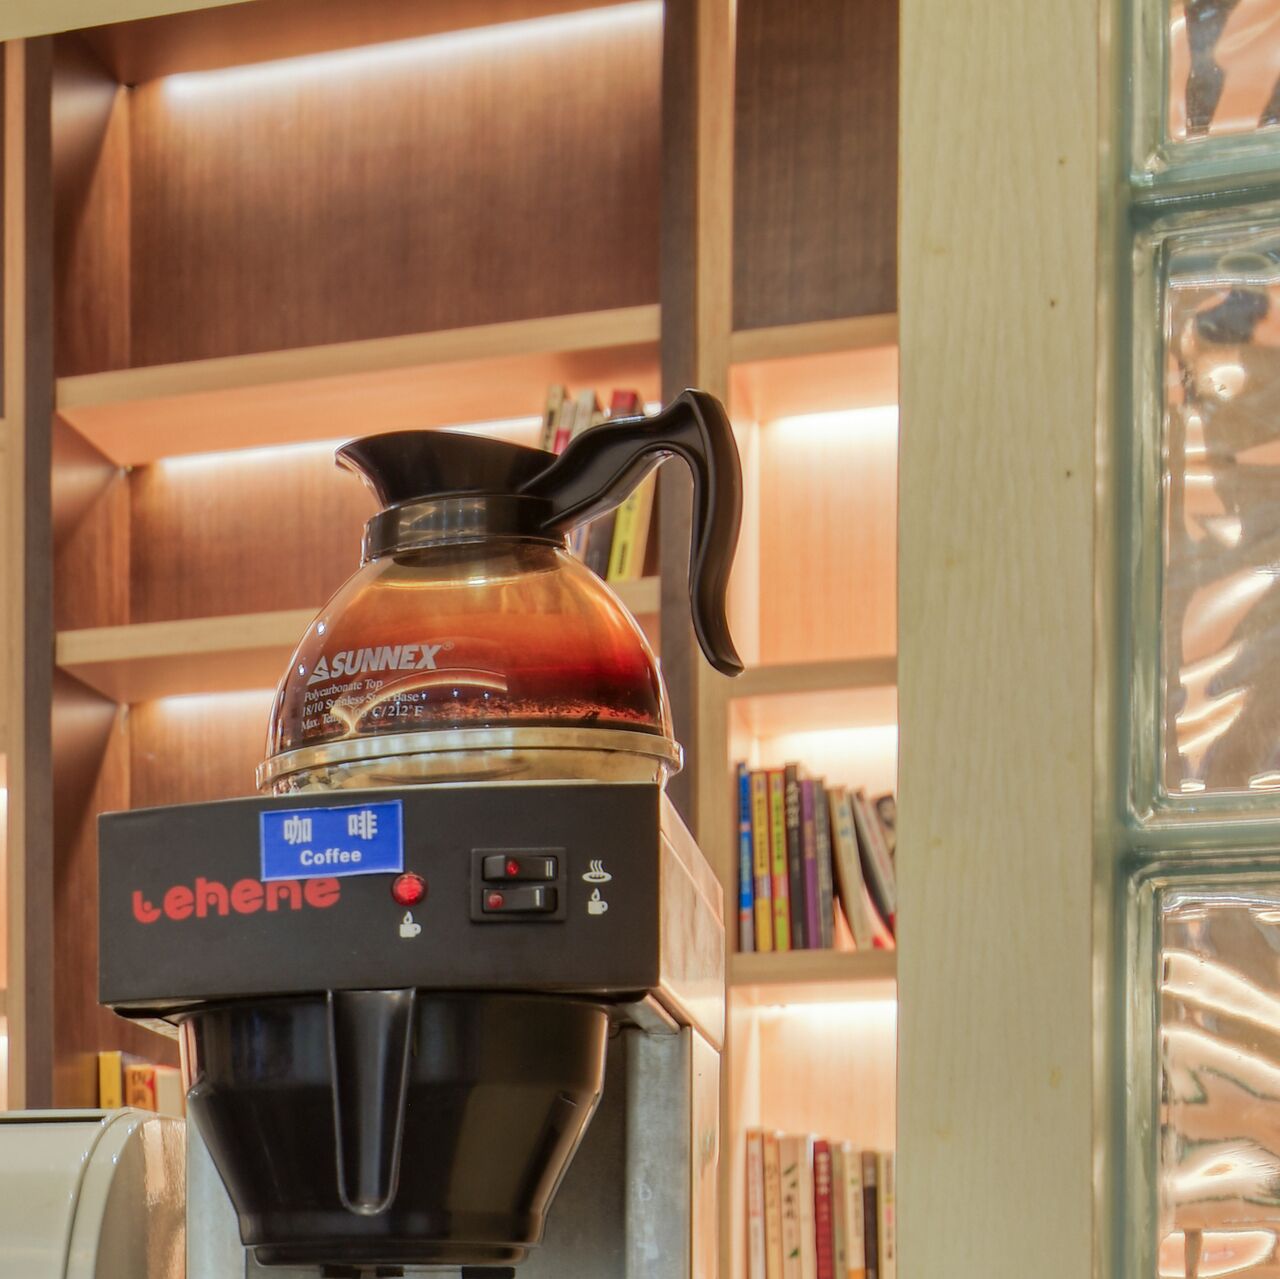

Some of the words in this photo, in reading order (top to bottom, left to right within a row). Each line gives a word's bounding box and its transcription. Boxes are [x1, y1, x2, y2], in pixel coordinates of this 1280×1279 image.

[330, 644, 441, 678] SUNNEX
[364, 679, 384, 690] Top
[283, 810, 378, 845] 咖啡
[300, 849, 362, 866] Coffee
